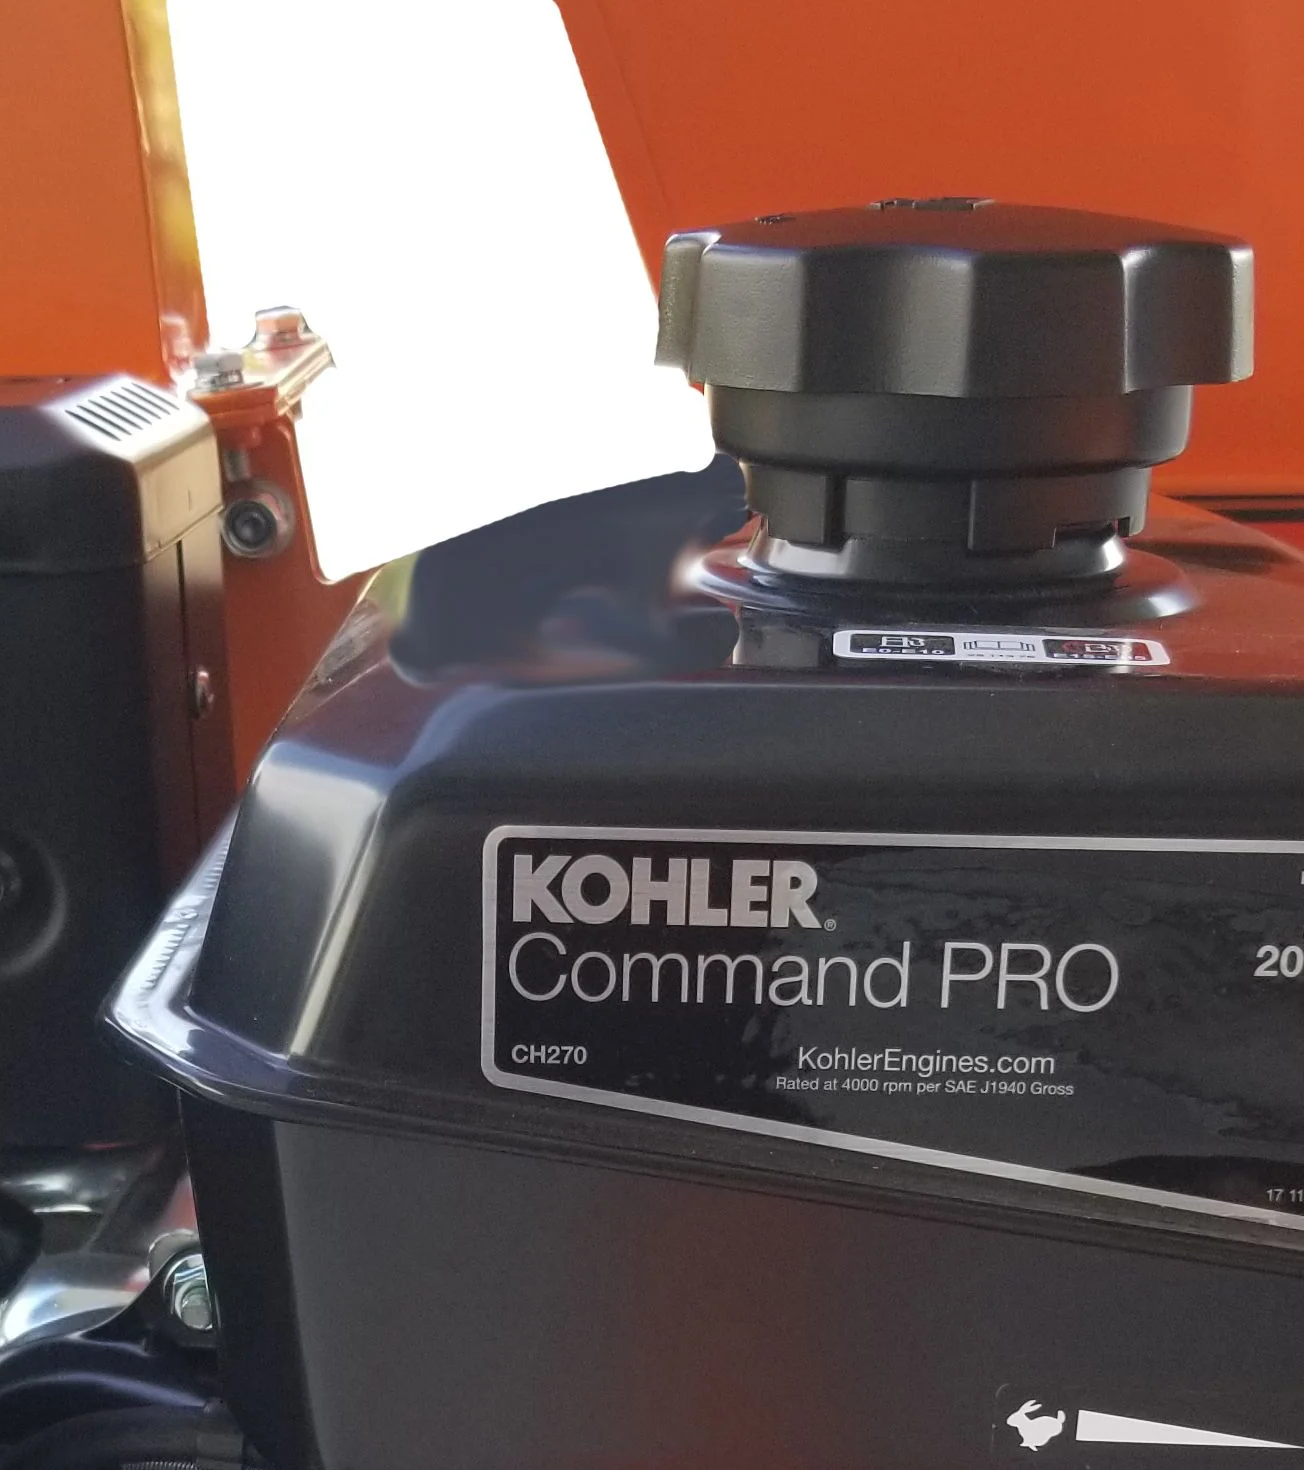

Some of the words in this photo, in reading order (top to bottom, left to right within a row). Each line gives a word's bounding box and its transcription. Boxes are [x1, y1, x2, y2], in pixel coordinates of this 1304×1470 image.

[508, 932, 910, 1007] Command
[940, 942, 1119, 1013] PRO
[511, 1044, 588, 1065] CH270
[798, 1046, 1055, 1078] KohlerEngines.com
[776, 1077, 819, 1091] Rated
[823, 1078, 838, 1091] at
[842, 1078, 879, 1092] 4000
[883, 1081, 912, 1094] rpm
[916, 1081, 940, 1094] per
[945, 1080, 976, 1093] SAE
[981, 1080, 1026, 1094] J1940
[1030, 1082, 1074, 1096] Gross
[1266, 1189, 1284, 1202] 17
